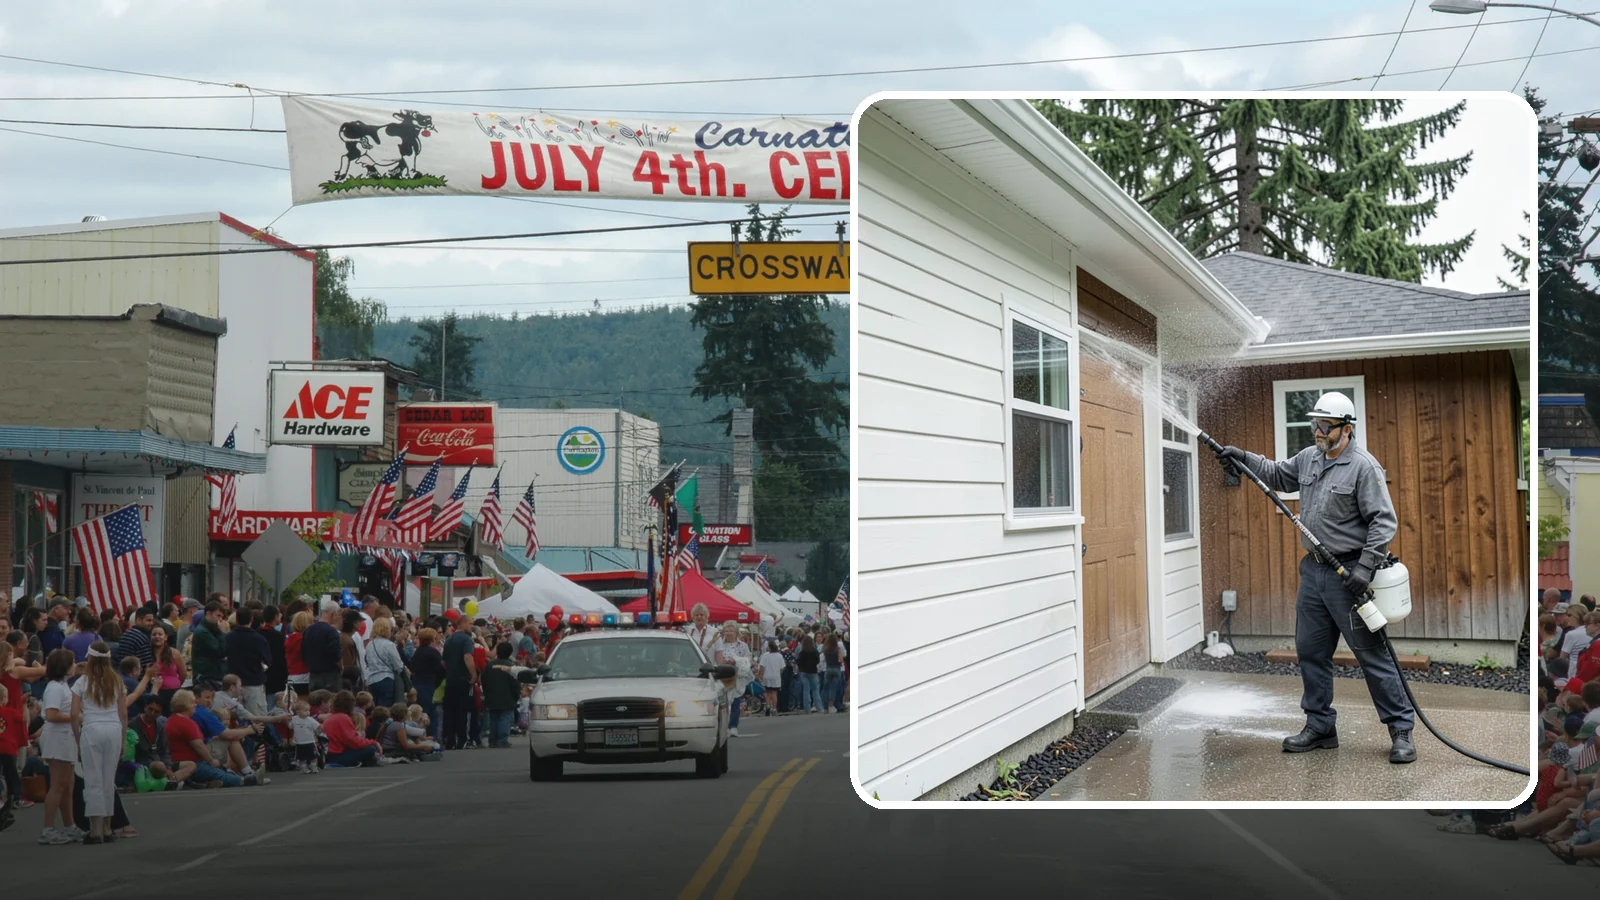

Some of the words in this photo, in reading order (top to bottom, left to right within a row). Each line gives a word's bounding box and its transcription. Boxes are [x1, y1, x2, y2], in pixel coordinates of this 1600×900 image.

[481, 141, 605, 192] JULY
[632, 150, 746, 197] 4th.
[697, 254, 850, 279] CROSSWA
[283, 380, 373, 420] ACE
[406, 409, 452, 421] CEDAR
[283, 421, 370, 436] Hardware
[416, 428, 477, 447] Coca-Cola
[83, 485, 93, 494] St.
[96, 485, 124, 494] Vincent
[126, 486, 136, 494] de
[138, 486, 155, 495] Paul
[688, 526, 741, 535] CRNATION
[699, 535, 730, 543] GLASS
